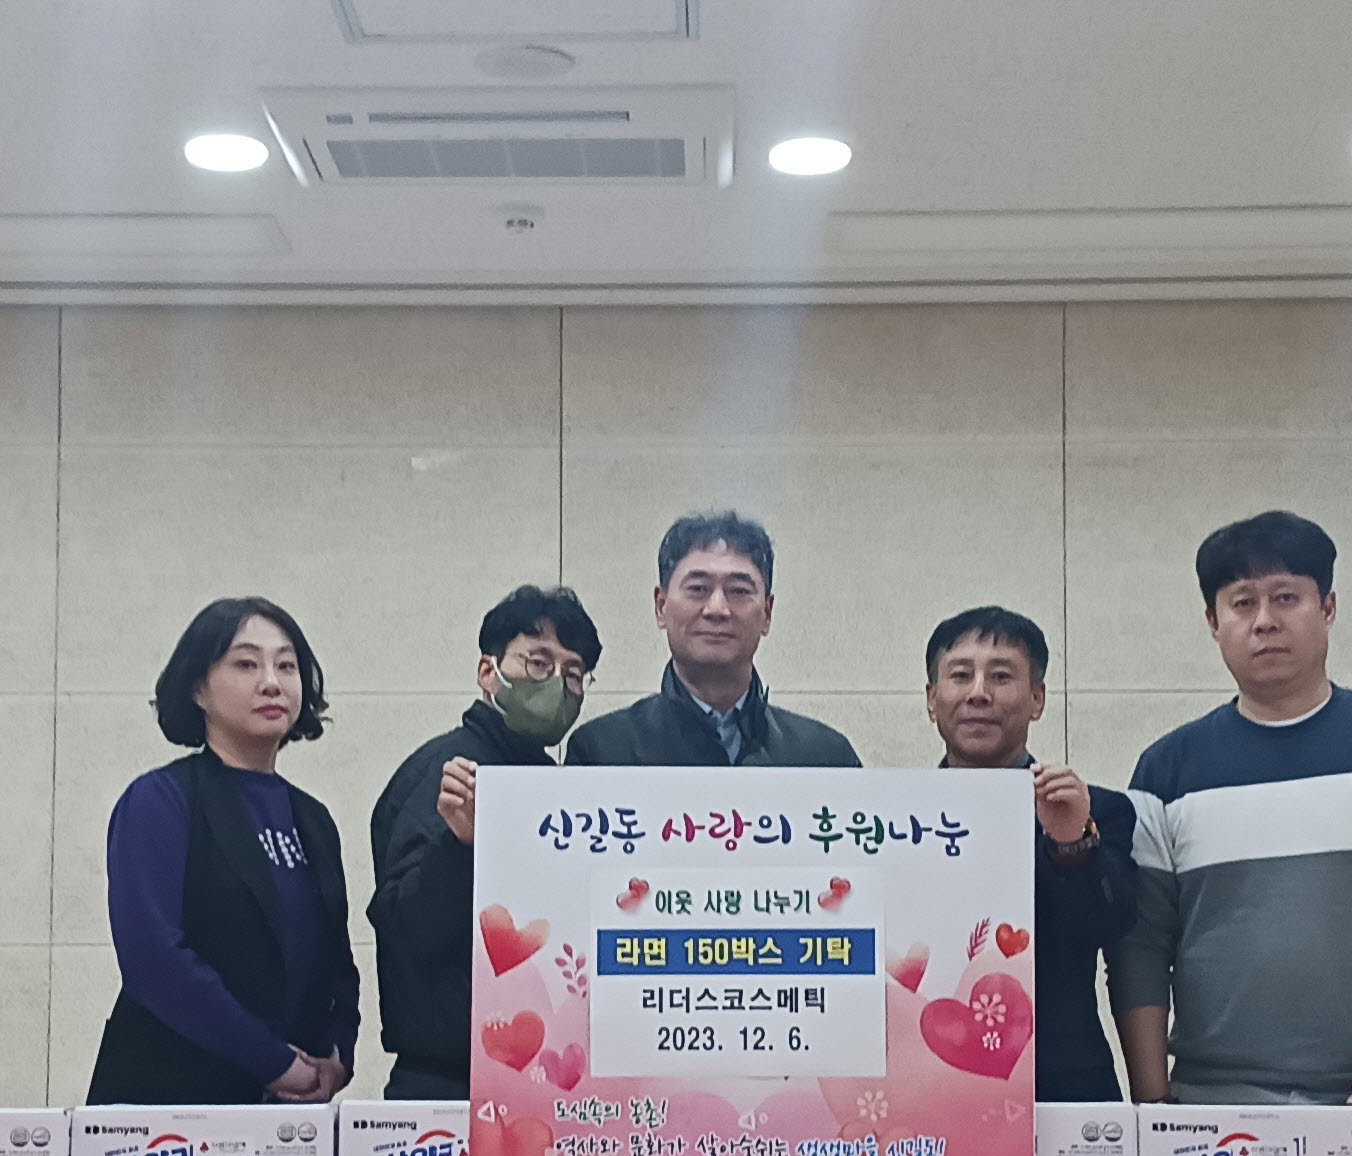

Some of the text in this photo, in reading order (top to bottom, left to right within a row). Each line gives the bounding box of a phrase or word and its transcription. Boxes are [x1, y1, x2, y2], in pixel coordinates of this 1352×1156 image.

[539, 806, 970, 856] 신길동 사랑의 후원나눔
[655, 889, 810, 915] 이웃 사랑 나누기
[616, 936, 851, 966] 라면 150박스 기탁
[642, 987, 826, 1014] 리더스코스메틱
[658, 1027, 810, 1052] 2023. 12. 6.
[555, 1097, 668, 1130] 도심속의 농촌!
